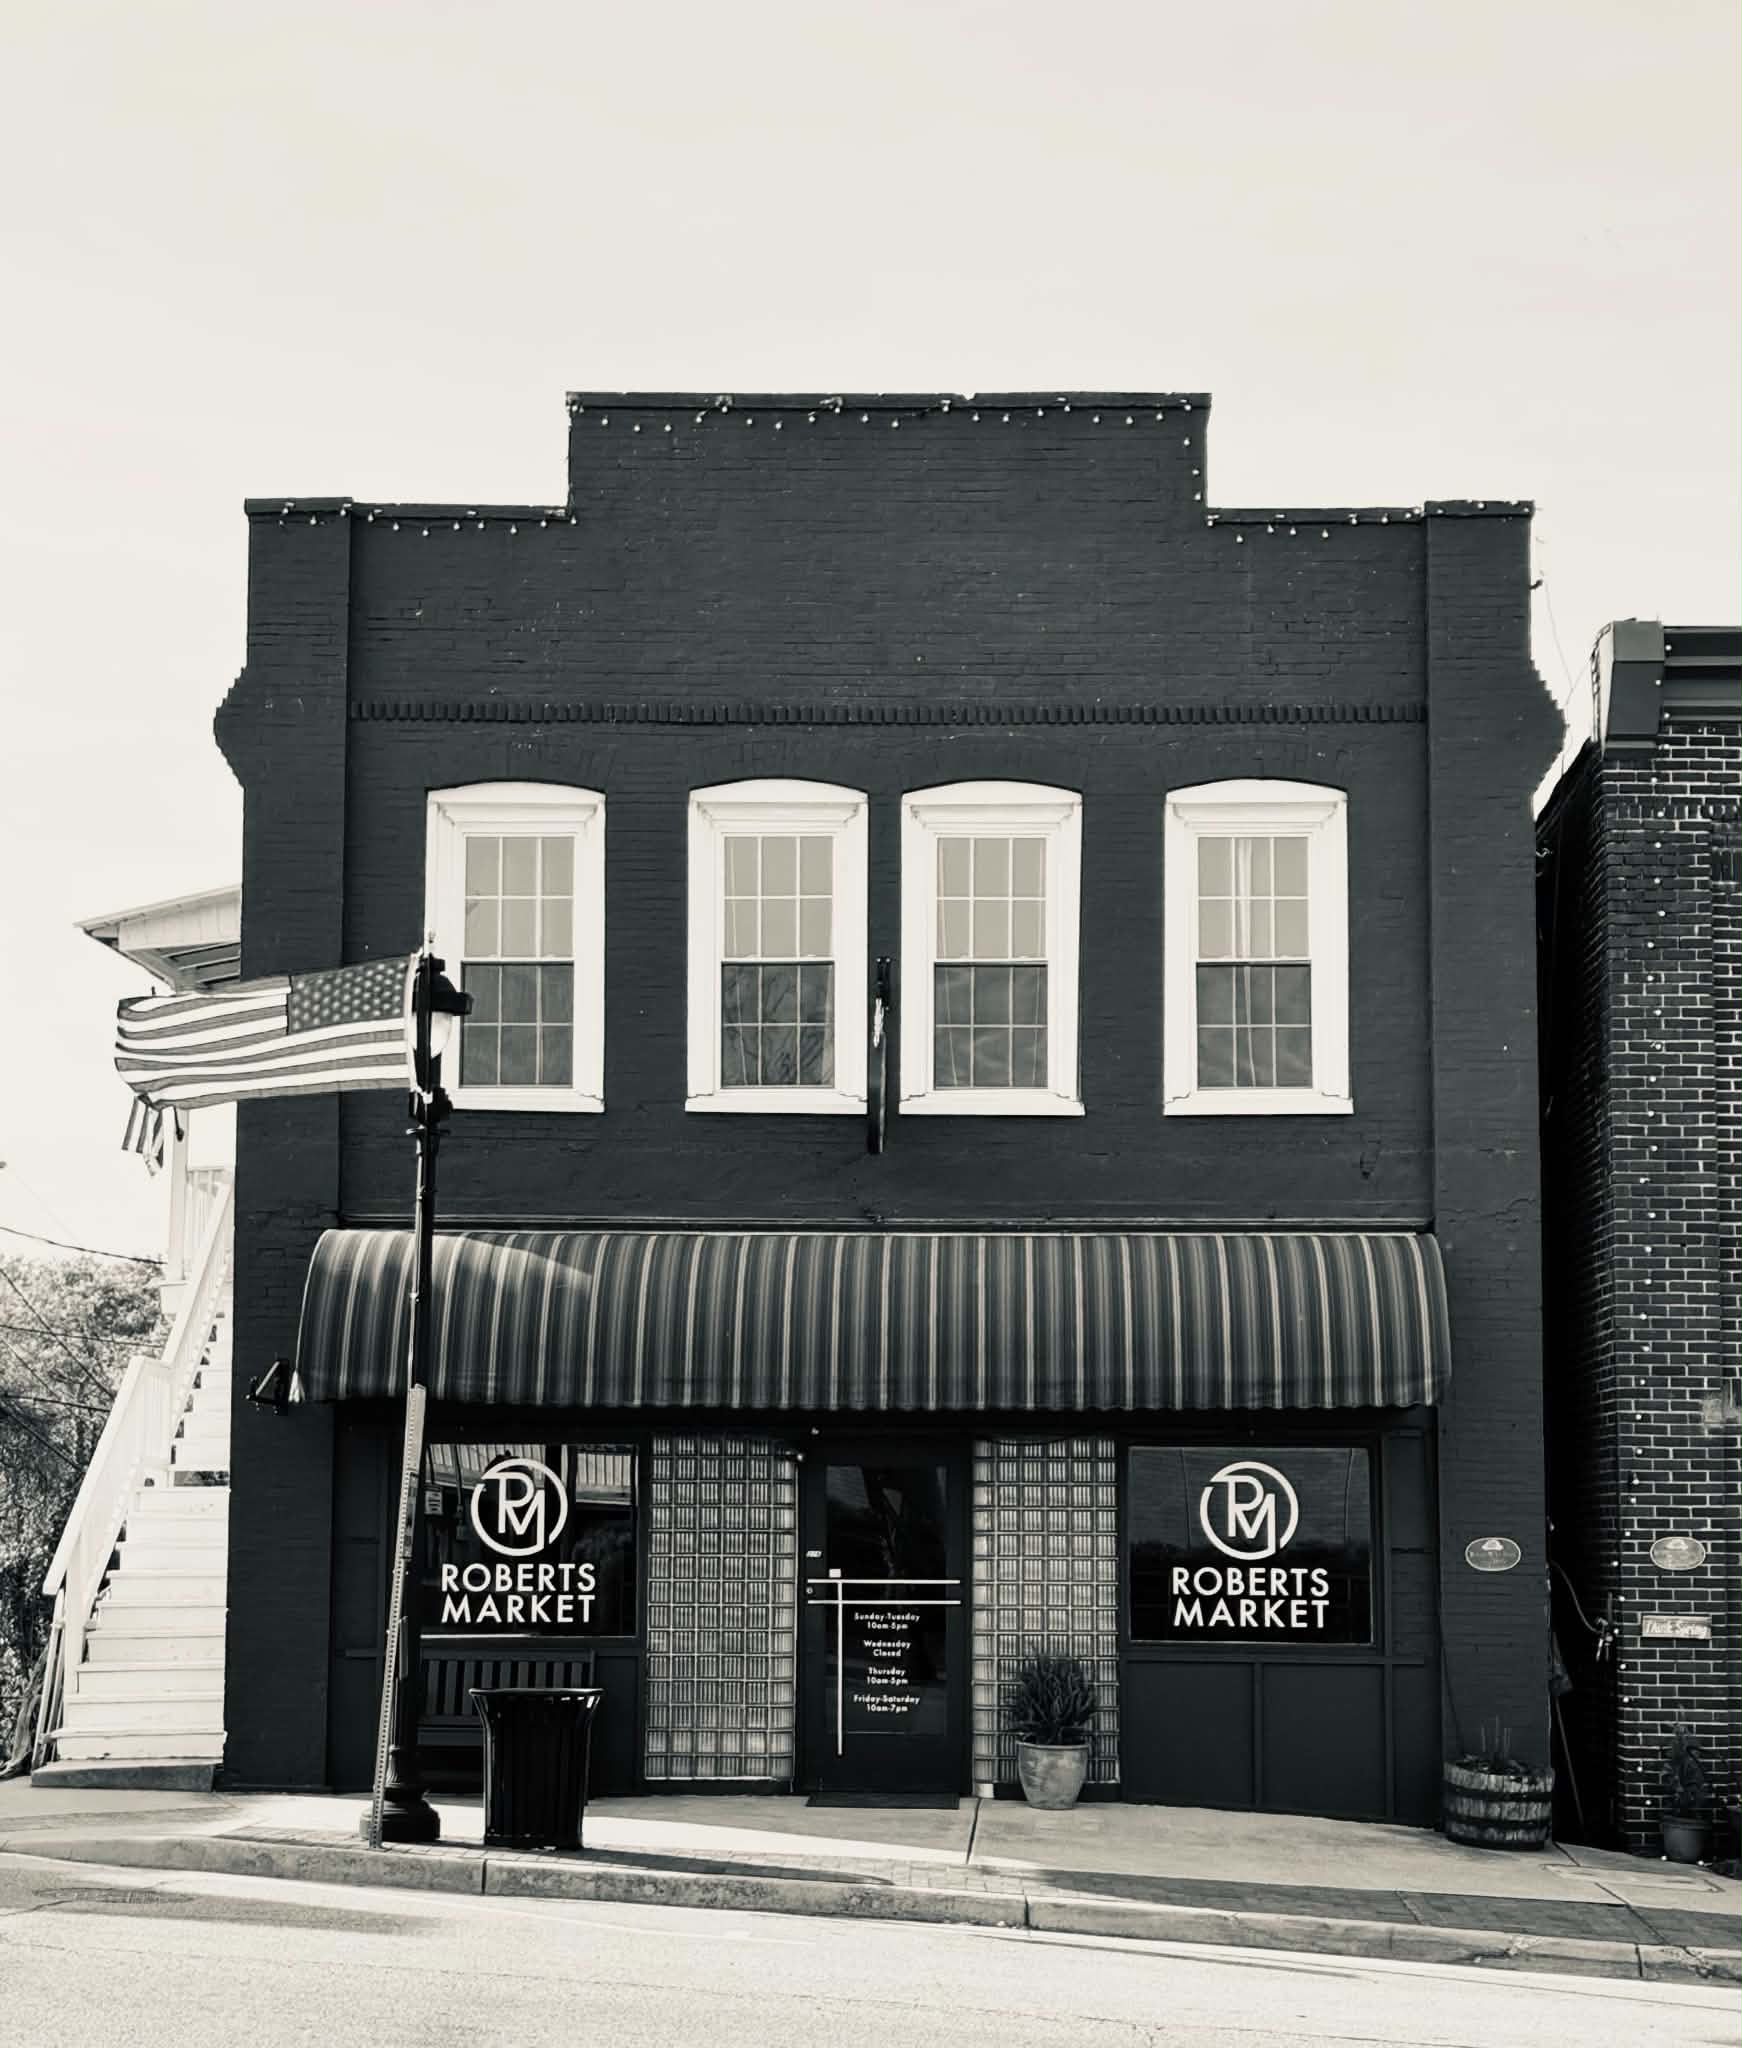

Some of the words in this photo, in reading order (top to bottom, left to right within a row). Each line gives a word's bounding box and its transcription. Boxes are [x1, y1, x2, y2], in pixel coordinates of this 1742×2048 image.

[441, 1563, 596, 1592] ROBERTS
[1172, 1566, 1329, 1597] ROBERTS
[441, 1594, 596, 1623] MARKET
[1173, 1597, 1330, 1628] MARKET
[854, 1612, 921, 1622] Sunday-Tuesday
[867, 1621, 909, 1631] 10am-5pm
[863, 1639, 912, 1649] Wednesday
[866, 1676, 909, 1686] 10am-5pm
[853, 1694, 921, 1704] Friday-Saturday
[866, 1704, 909, 1713] 10am-7pm
